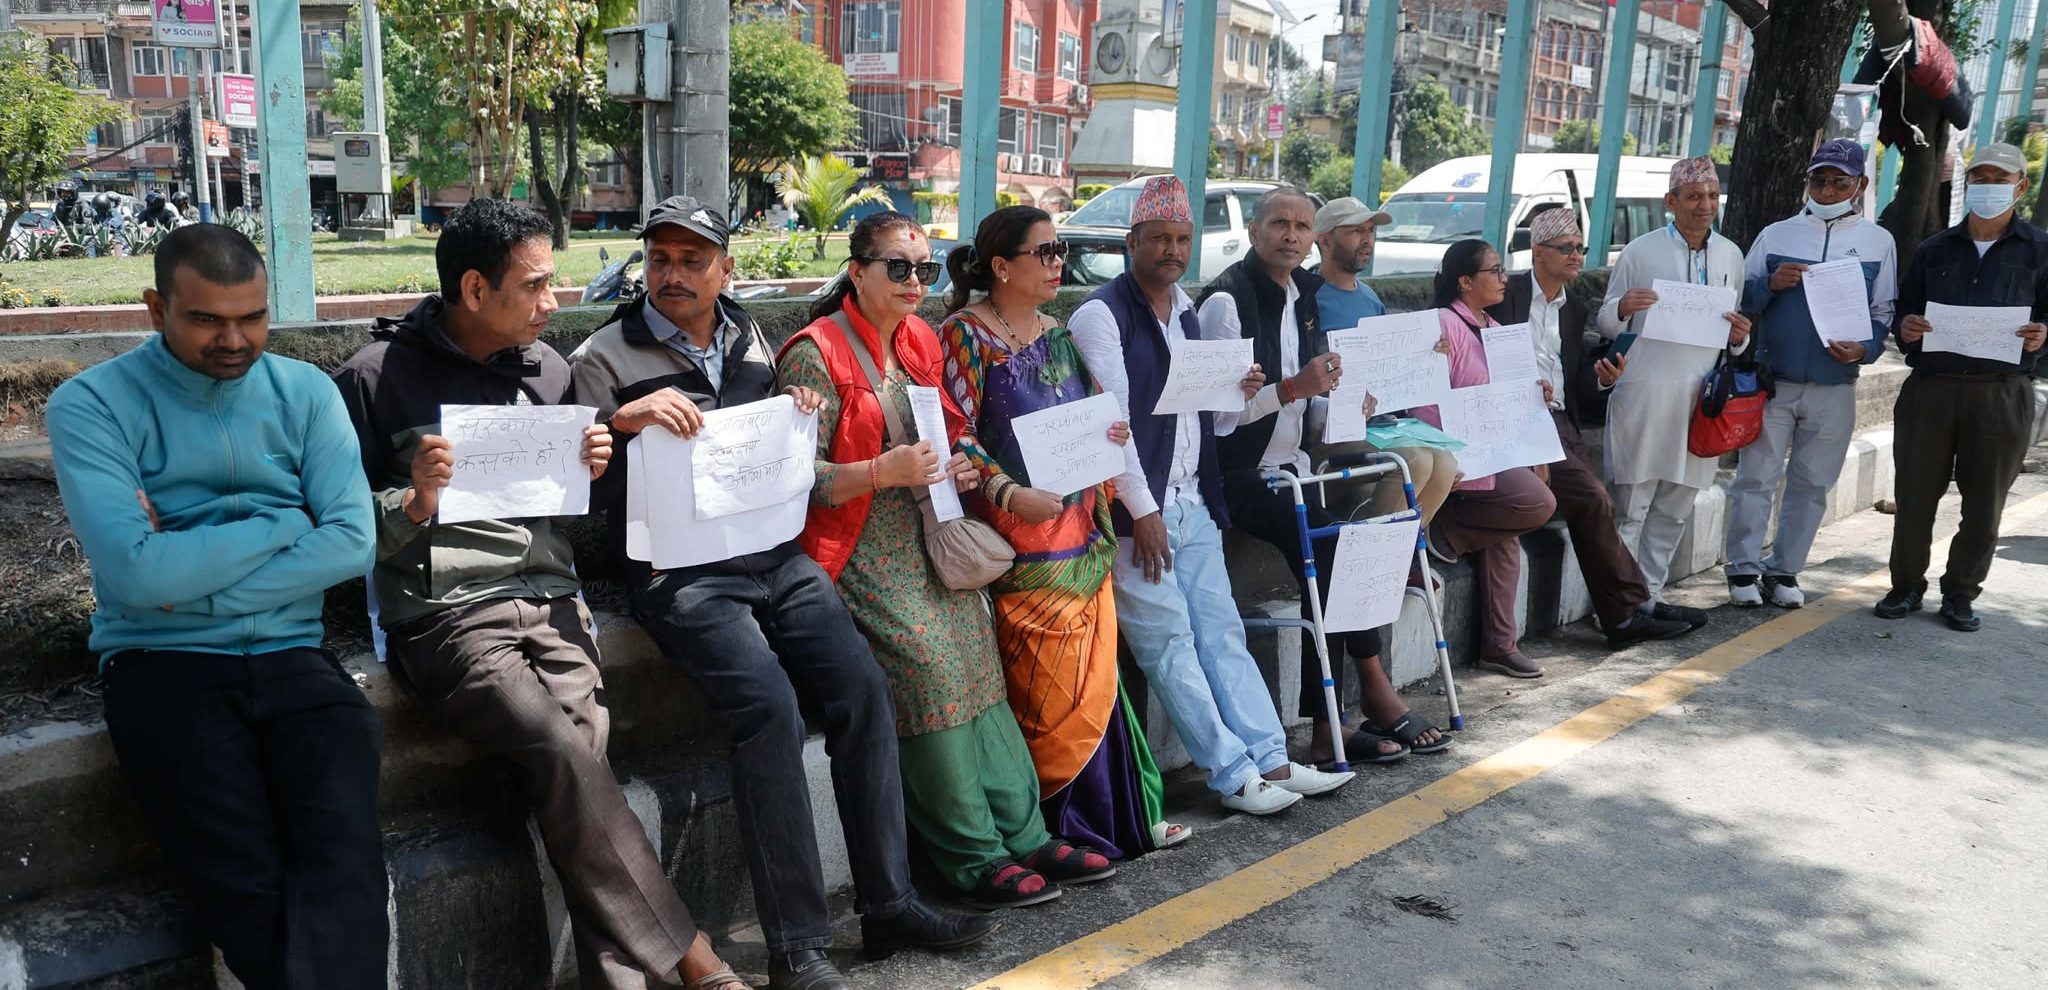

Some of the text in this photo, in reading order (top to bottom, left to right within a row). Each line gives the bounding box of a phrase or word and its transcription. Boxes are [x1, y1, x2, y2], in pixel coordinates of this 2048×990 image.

[173, 27, 213, 37] SOCIAIR
[456, 417, 546, 445] सरकार
[456, 438, 572, 486] कसको हो ?
